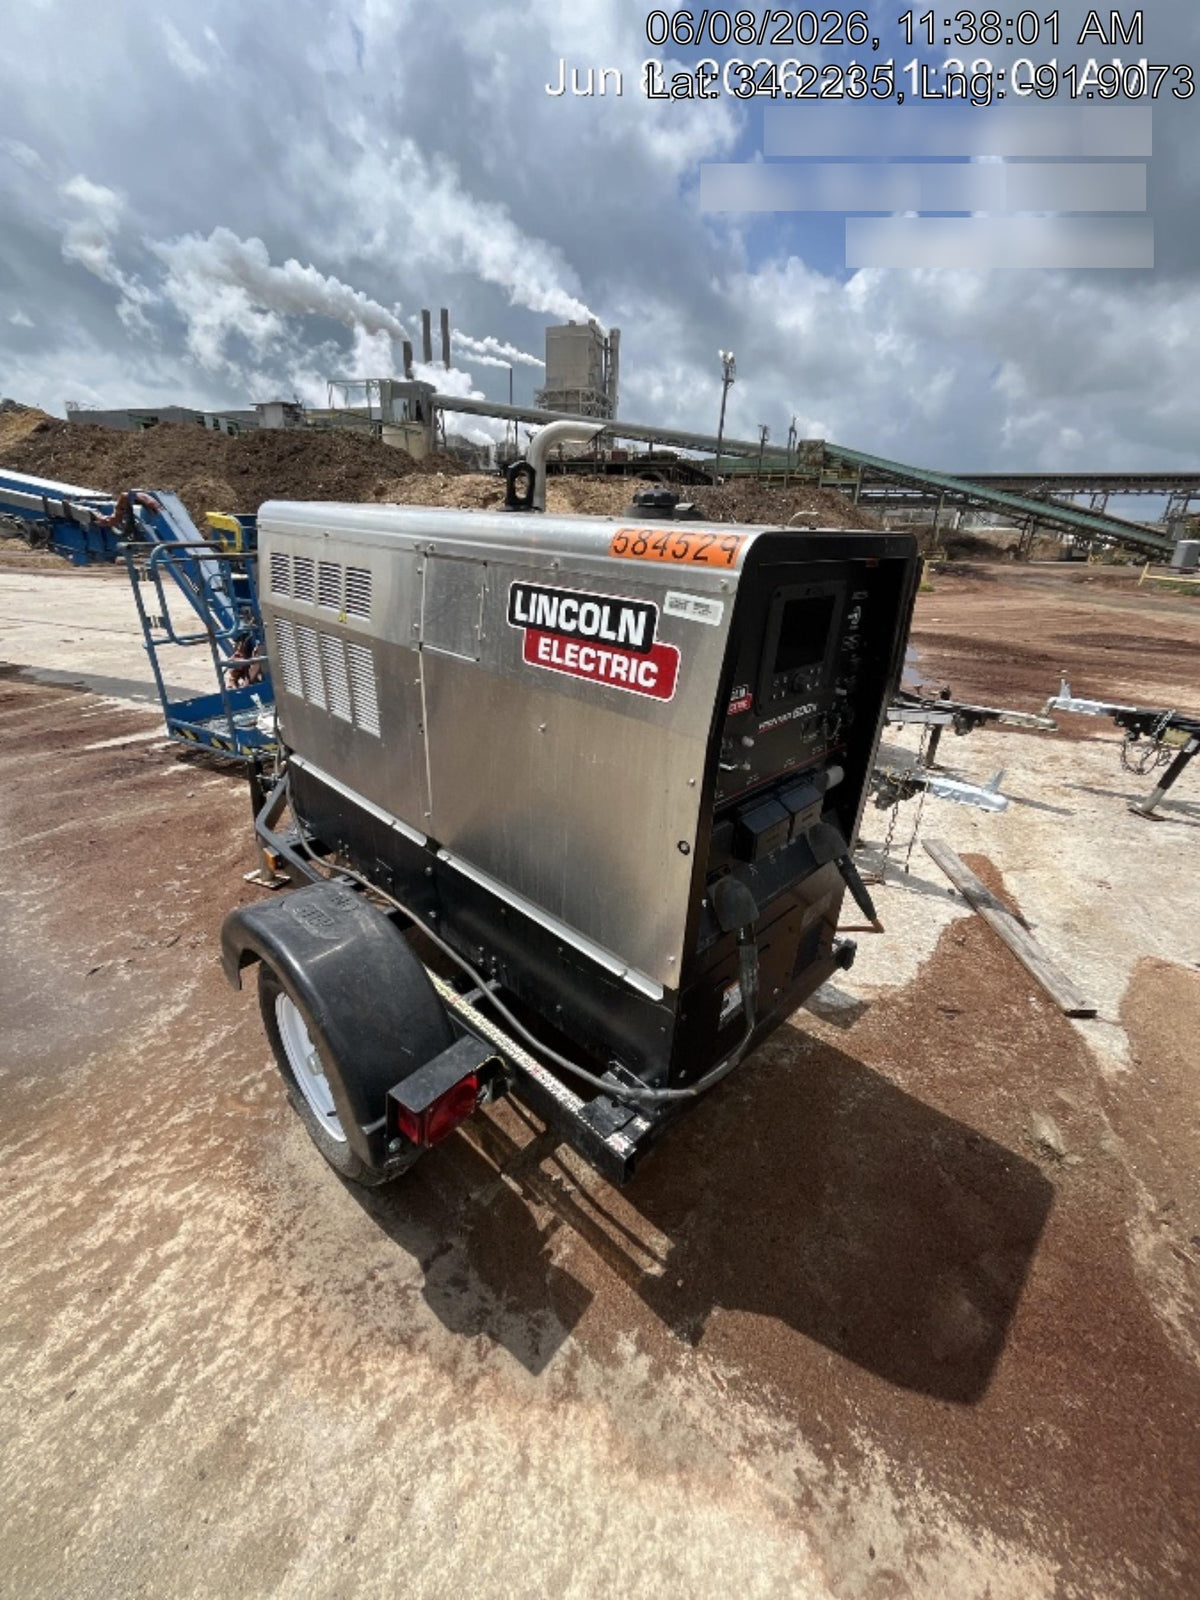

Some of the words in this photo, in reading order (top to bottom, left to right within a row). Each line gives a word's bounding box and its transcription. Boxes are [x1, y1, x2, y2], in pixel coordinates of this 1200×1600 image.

[613, 529, 741, 565] 584529
[514, 590, 647, 647] LINCOLN
[537, 636, 659, 688] ELECTRIC
